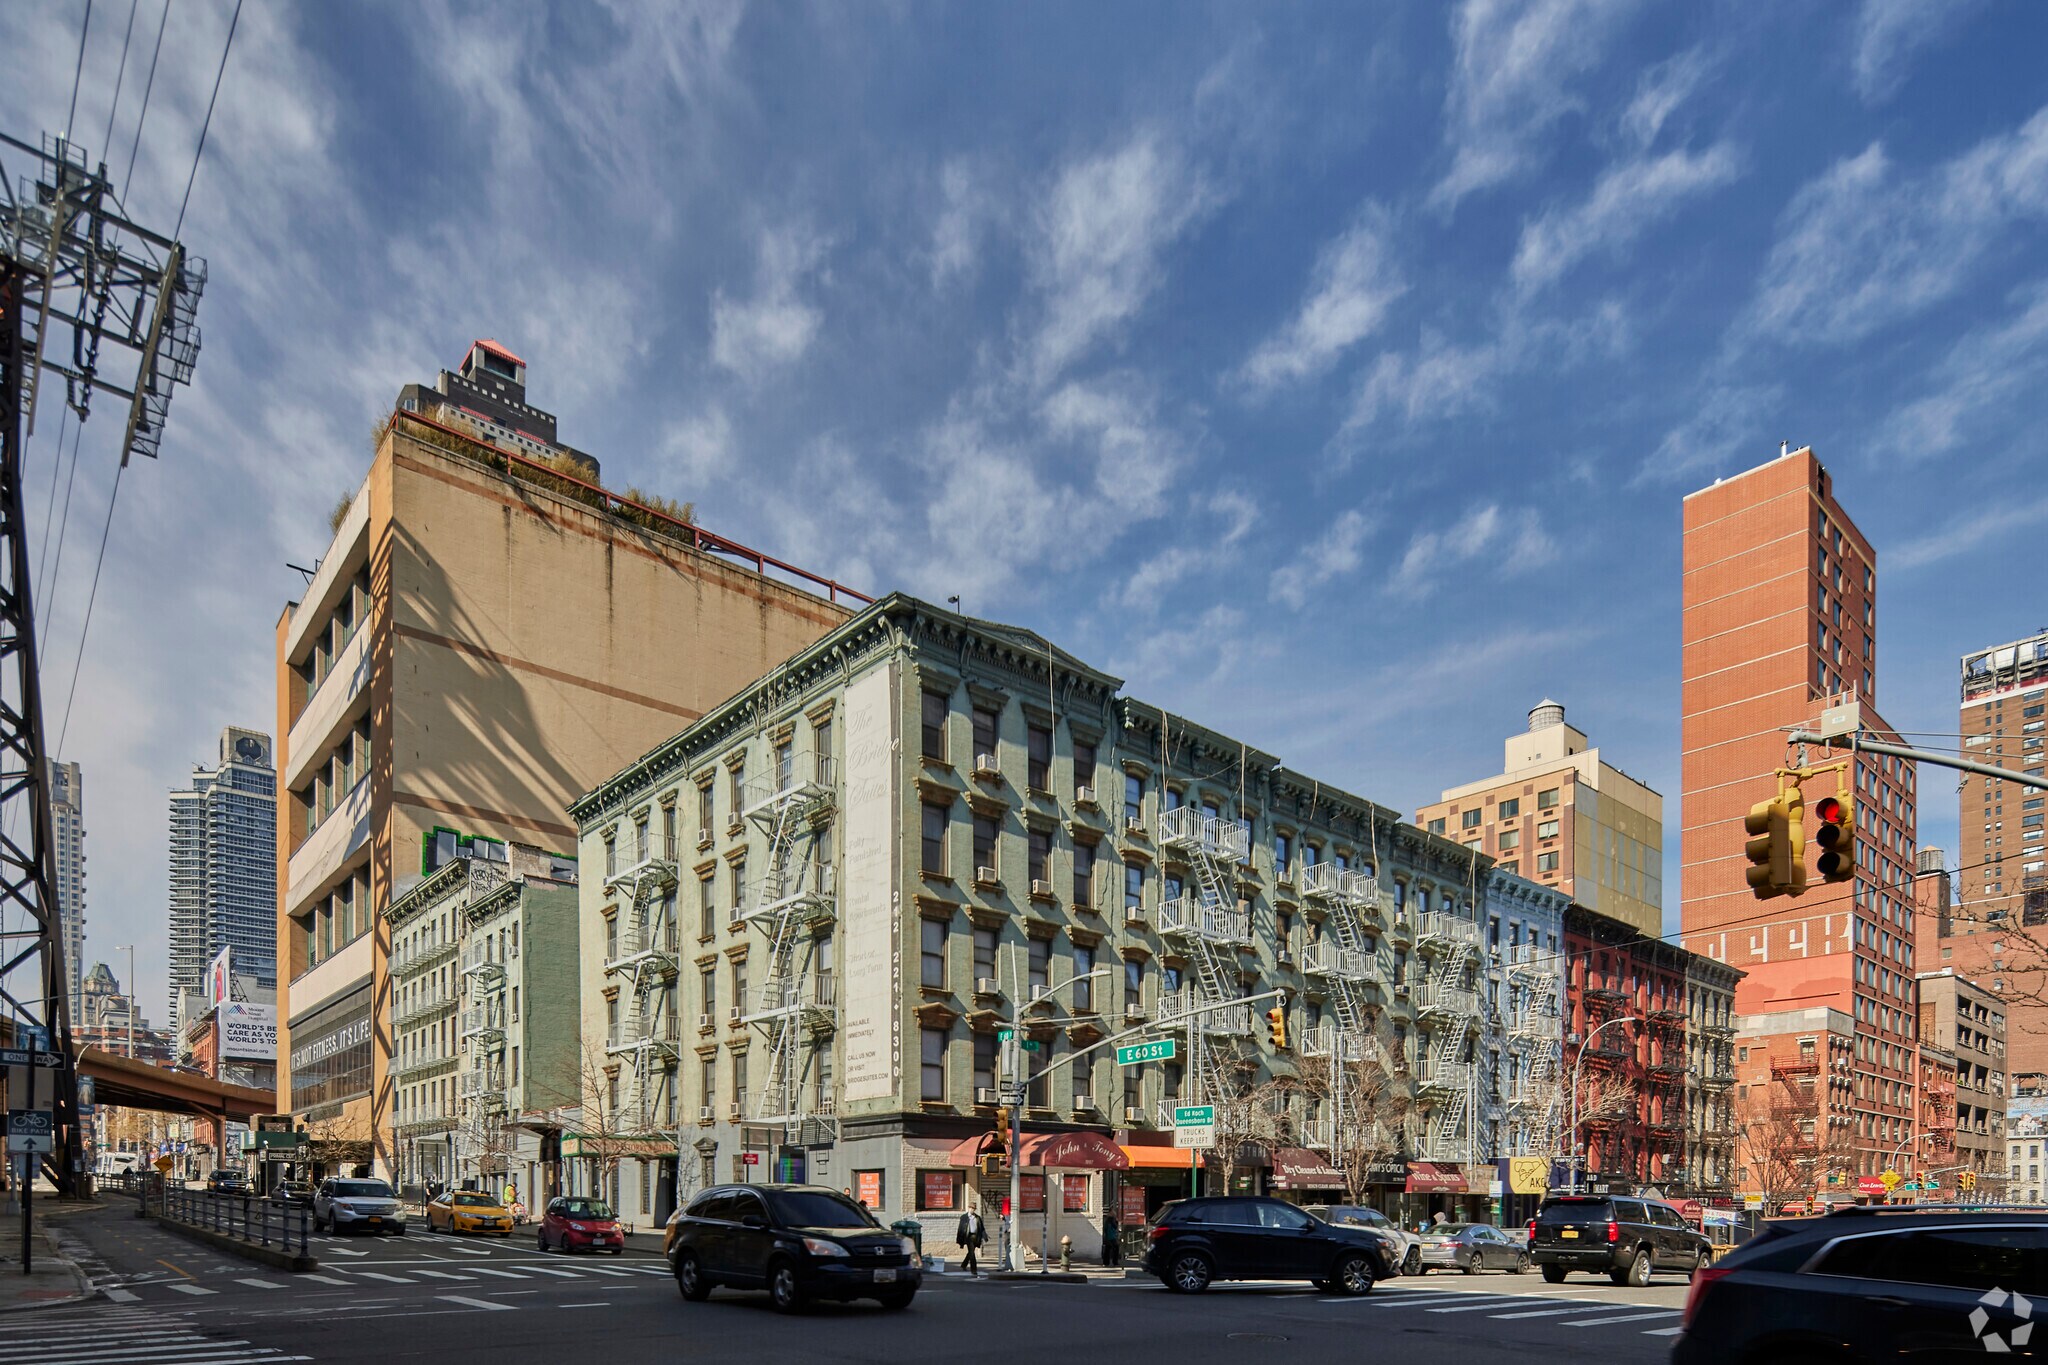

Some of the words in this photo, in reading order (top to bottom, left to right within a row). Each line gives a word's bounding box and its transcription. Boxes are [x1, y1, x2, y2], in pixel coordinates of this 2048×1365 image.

[227, 1022, 264, 1030] WORLD'S
[848, 1018, 870, 1028] AVAILABLE
[848, 1029, 874, 1039] IMMEDIATELY
[291, 1052, 300, 1070] IT'S
[301, 1046, 312, 1064] NOT
[313, 1035, 338, 1060] FITNESS.
[340, 1027, 352, 1049] IT'S
[354, 1020, 371, 1042] LIFE.
[1127, 1050, 1133, 1060] E
[1135, 1047, 1148, 1058] 60
[1151, 1045, 1163, 1056] St
[848, 1073, 888, 1084] BRIDGESUITES.COM
[1056, 1141, 1080, 1163] John
[1092, 1141, 1121, 1166] Tony's
[1282, 1163, 1295, 1176] Dry
[1412, 1171, 1432, 1181] Wine
[1435, 1171, 1460, 1184] Spirits
